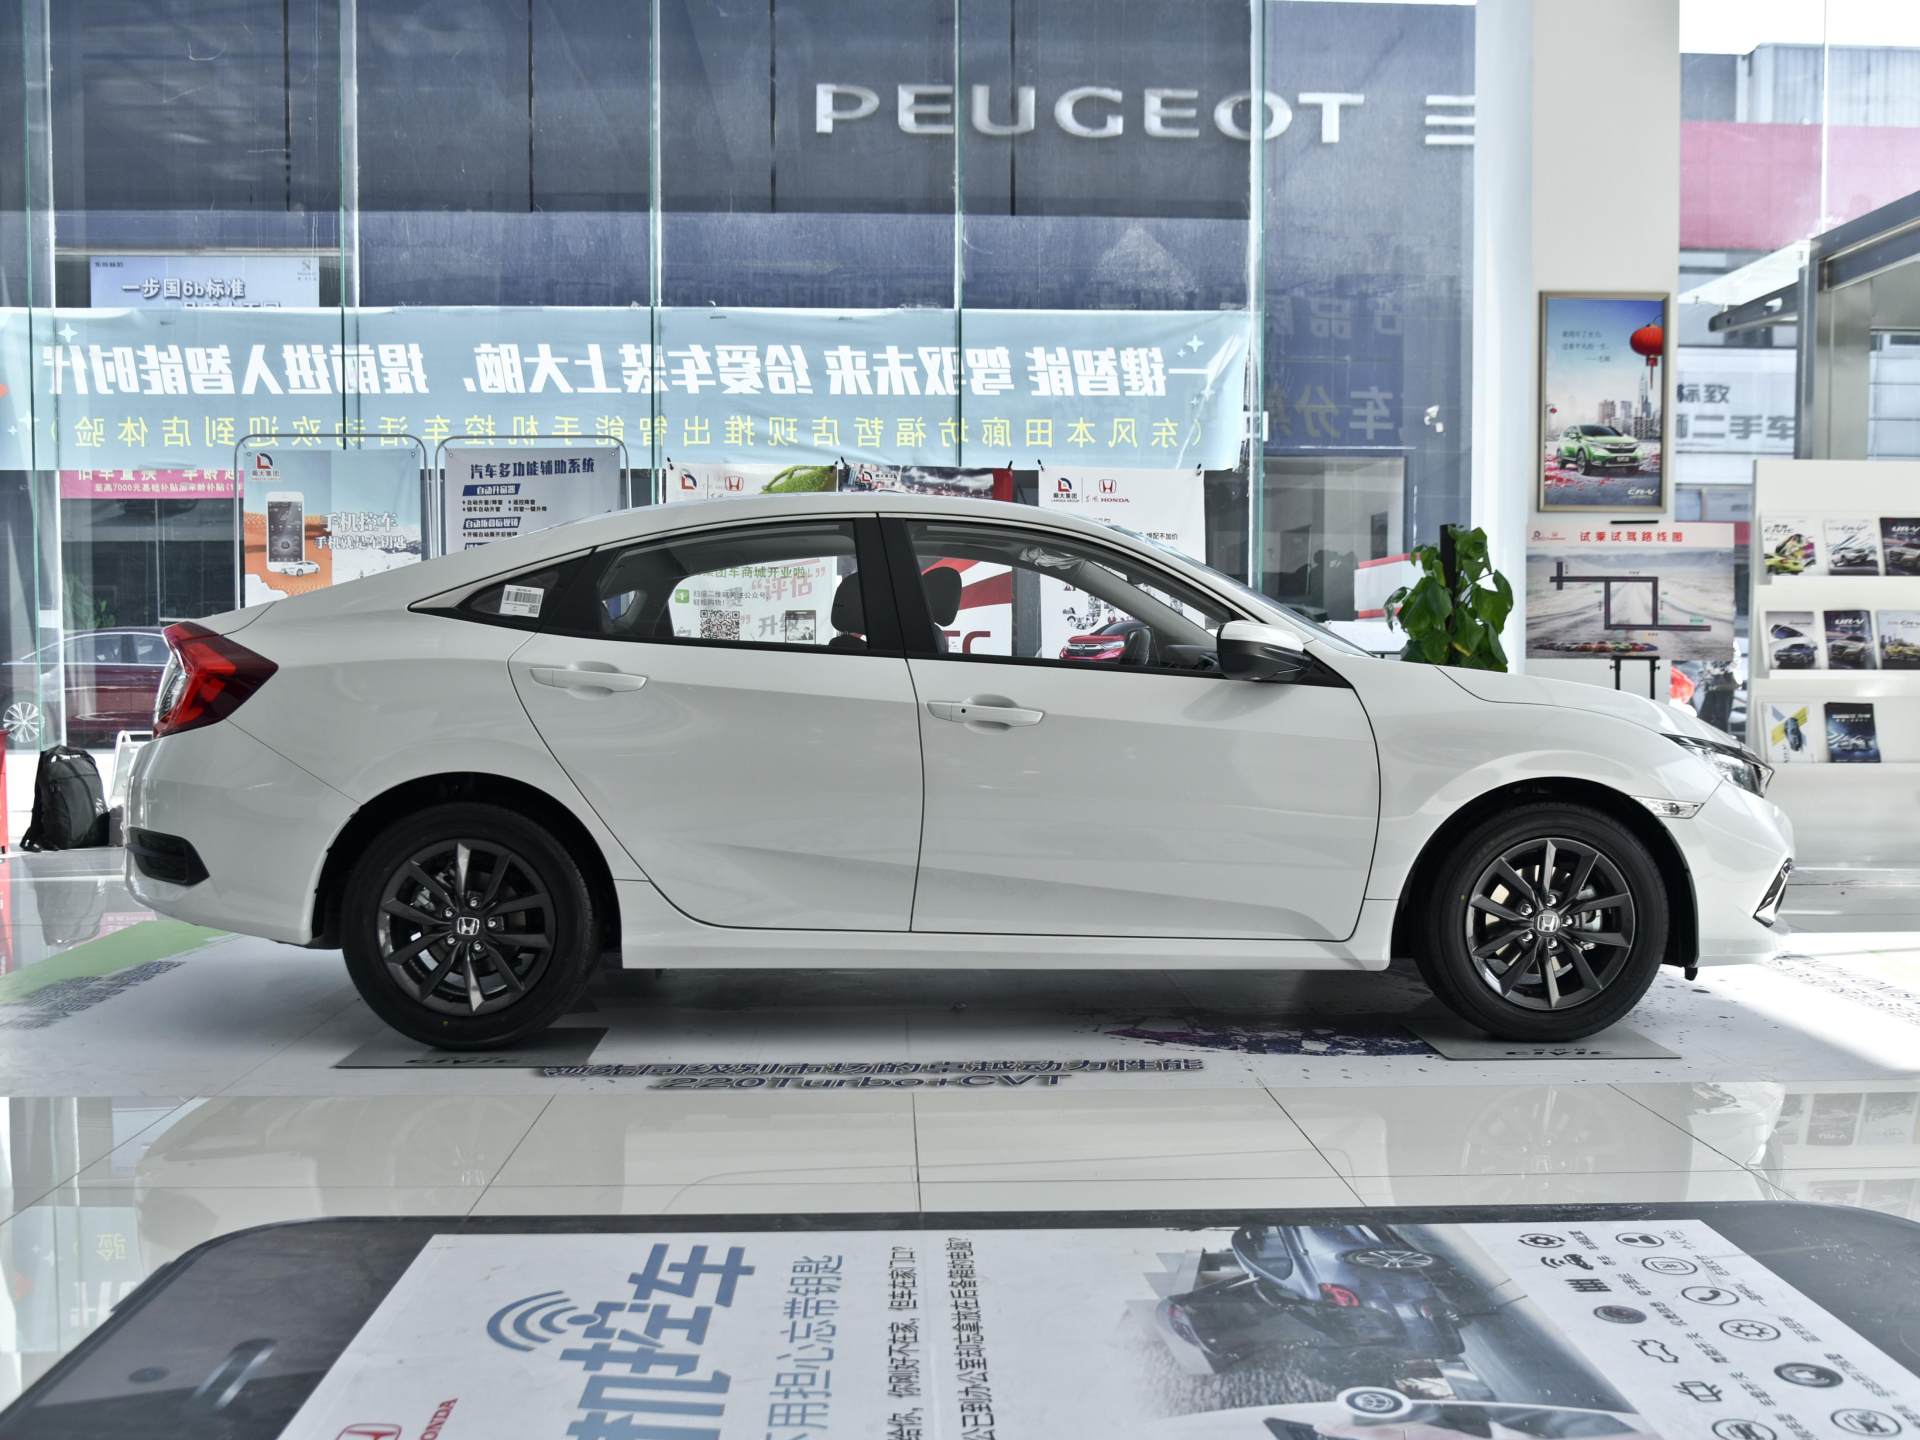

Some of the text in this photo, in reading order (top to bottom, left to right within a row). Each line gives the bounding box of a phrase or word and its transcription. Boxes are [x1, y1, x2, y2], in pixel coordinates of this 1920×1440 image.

[815, 82, 1365, 144] PEUGEOT
[121, 279, 246, 298] 一步国6b标准
[470, 458, 595, 479] 汽车多功能辅助系统
[322, 512, 399, 533] 手机控车
[1579, 531, 1684, 543] 试乘试驾路线图
[655, 1074, 1072, 1089] 220Turbo+CVT
